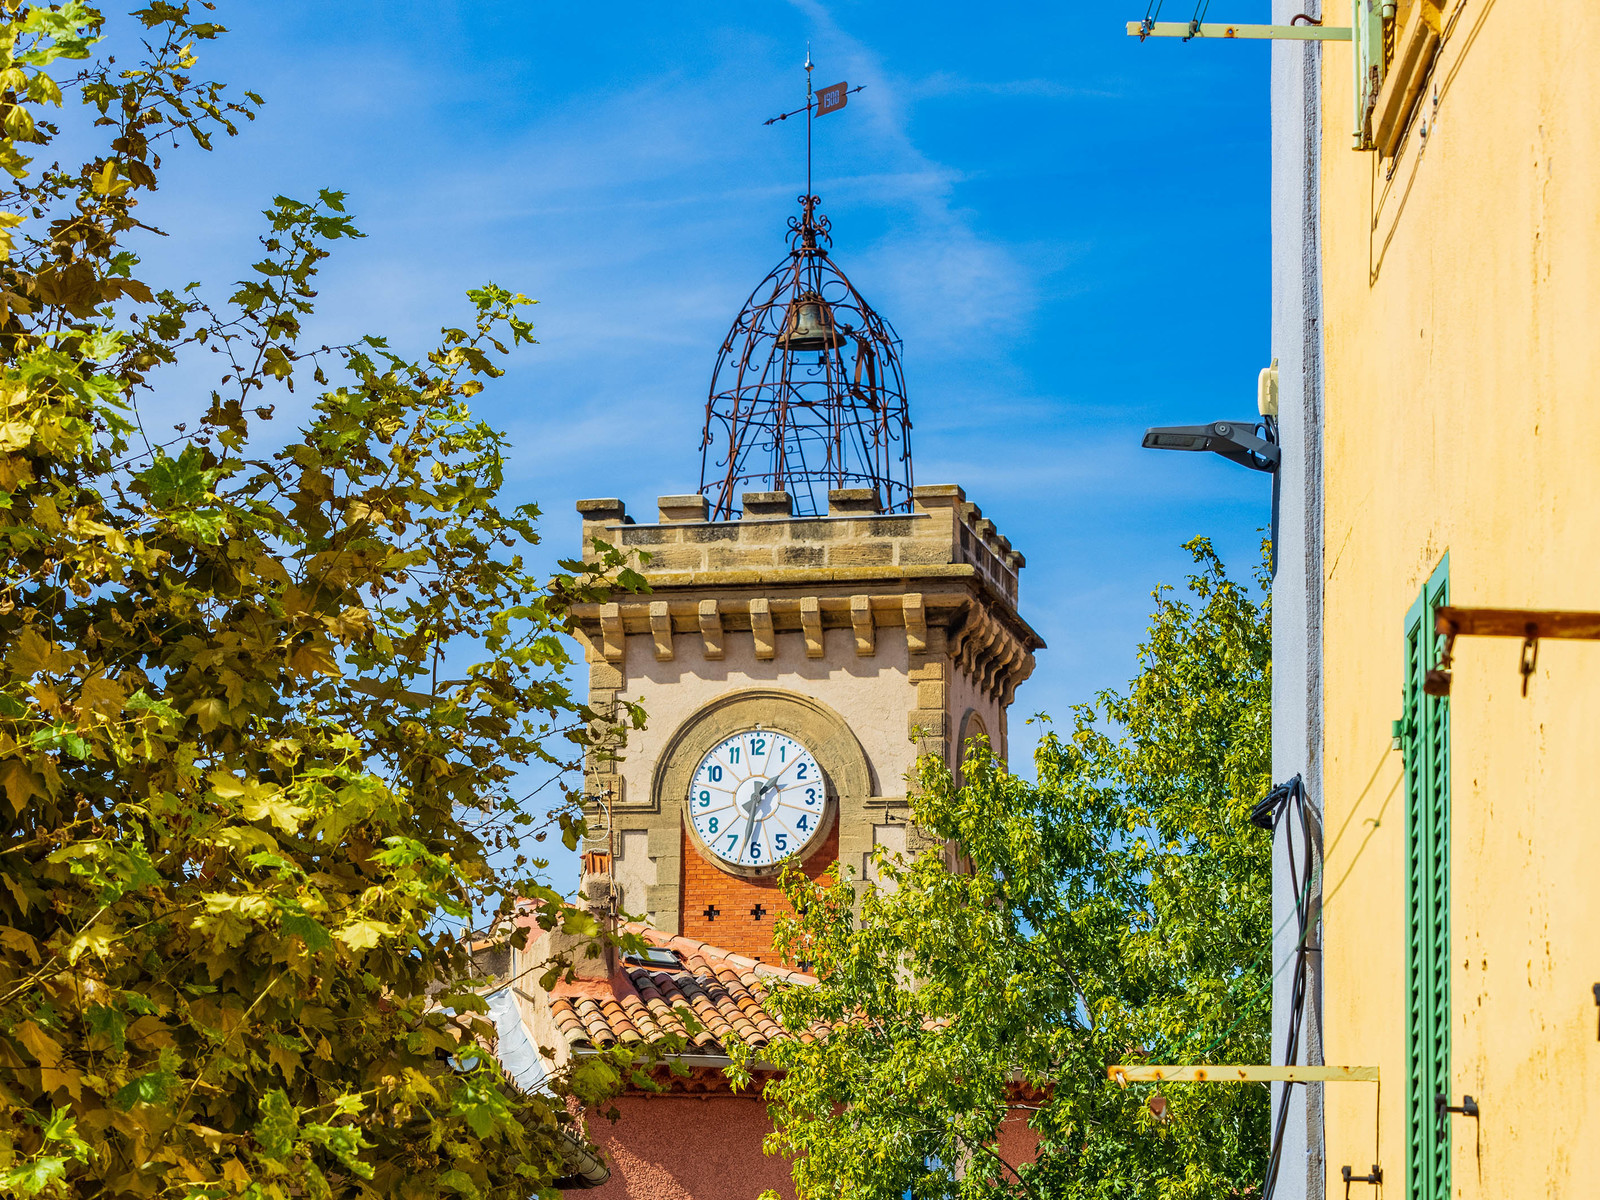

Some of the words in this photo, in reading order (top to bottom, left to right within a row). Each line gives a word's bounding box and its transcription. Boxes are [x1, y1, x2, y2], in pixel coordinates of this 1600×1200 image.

[823, 90, 840, 109] 1900
[729, 746, 740, 764] 11
[750, 738, 766, 755] 12
[780, 745, 786, 763] 1
[707, 765, 723, 782] 10
[796, 762, 807, 780] 2
[698, 790, 711, 807] 9
[805, 788, 816, 805] 3
[708, 817, 719, 834] 8
[796, 814, 808, 832] 4
[727, 834, 739, 852] 7
[750, 841, 761, 859] 6
[775, 834, 787, 851] 5
